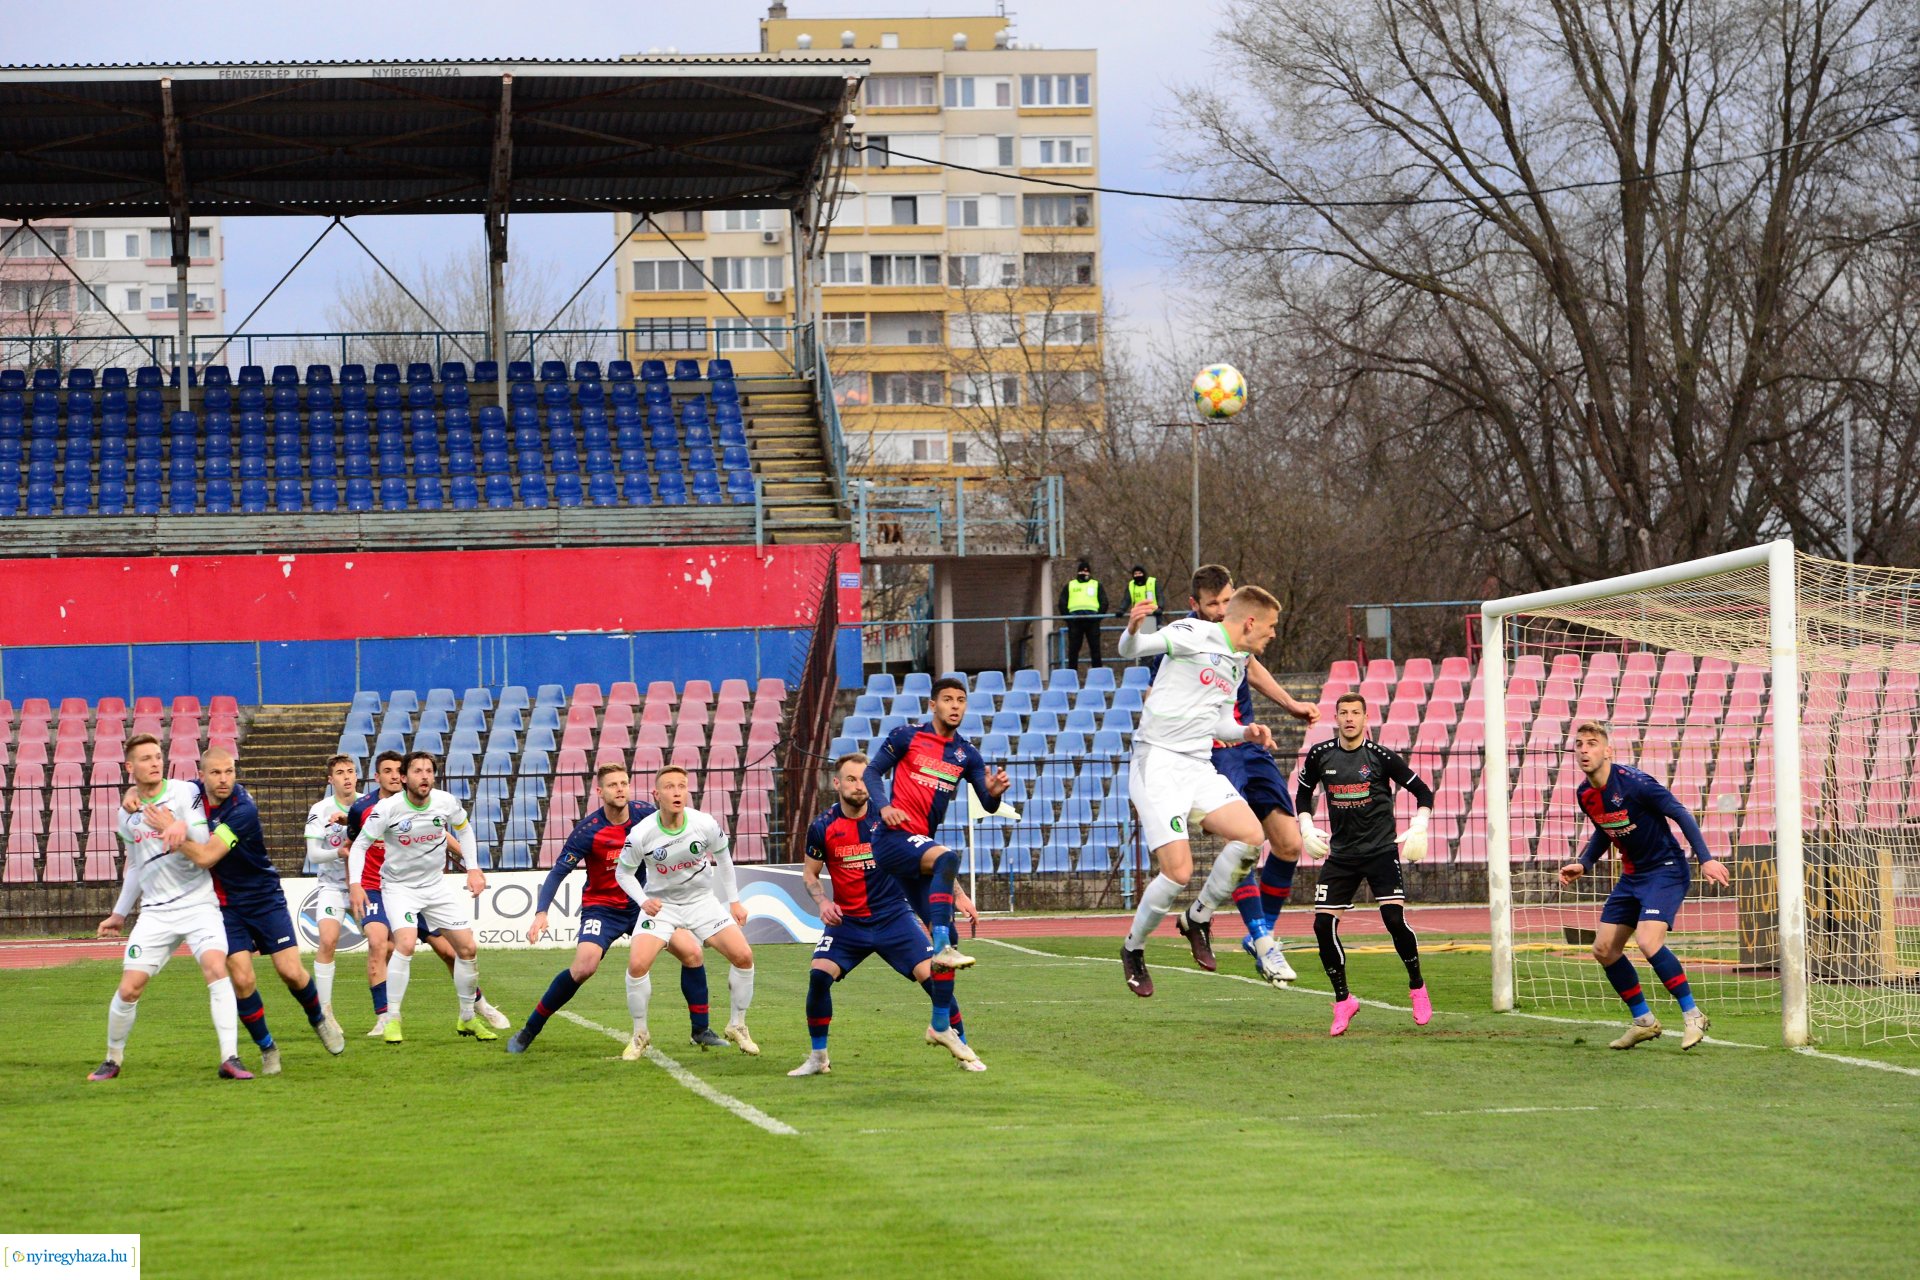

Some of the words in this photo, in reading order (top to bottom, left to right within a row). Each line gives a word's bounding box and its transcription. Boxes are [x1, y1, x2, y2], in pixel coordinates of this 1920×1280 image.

[219, 68, 291, 80] FÉMSZER-ÉP
[296, 69, 321, 80] KFT.
[372, 66, 461, 78] NYÍREGYHÁZA
[582, 918, 602, 936] 28
